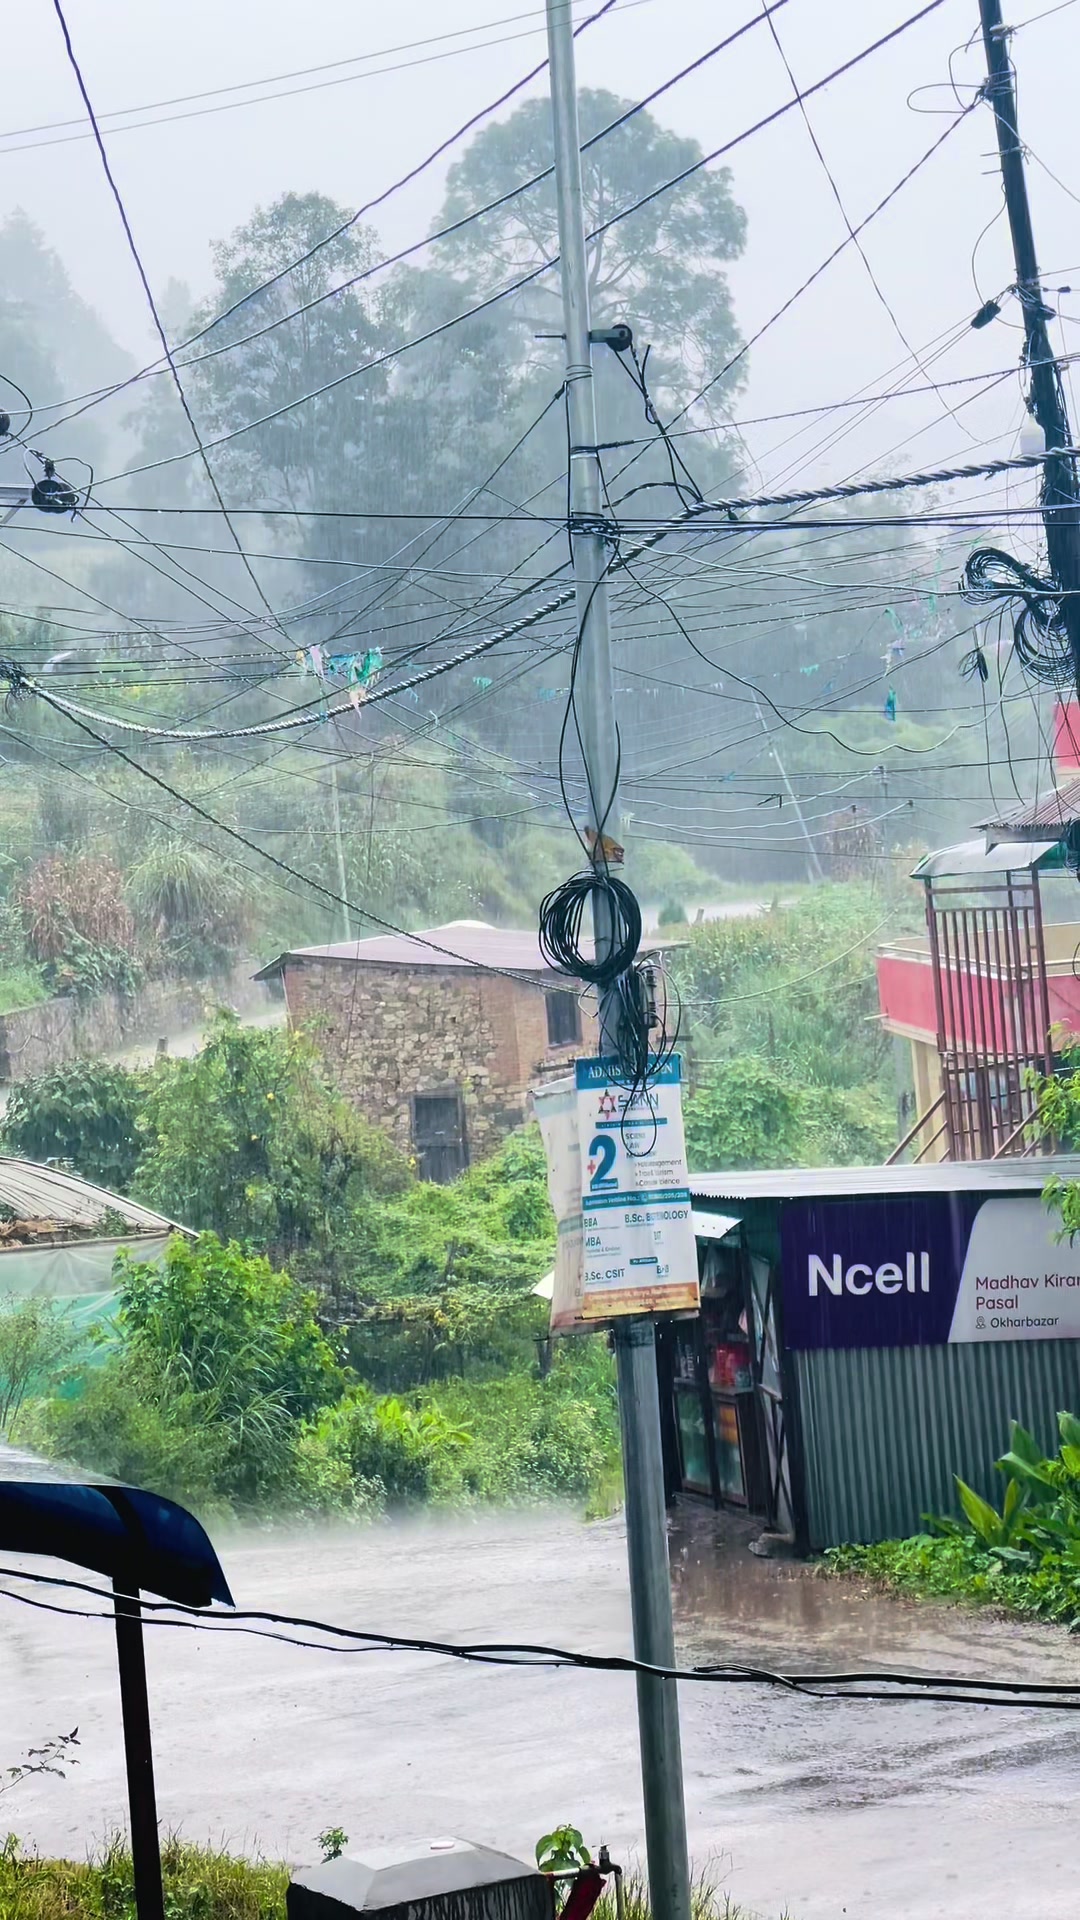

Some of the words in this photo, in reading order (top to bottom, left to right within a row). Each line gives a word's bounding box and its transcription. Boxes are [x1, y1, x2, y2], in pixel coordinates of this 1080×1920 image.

[605, 1268, 625, 1279] CSIT
[808, 1251, 930, 1296] Ncell
[976, 1275, 1039, 1290] Madhav
[976, 1295, 1018, 1310] Pasal
[990, 1316, 1059, 1328] Okharbazar
